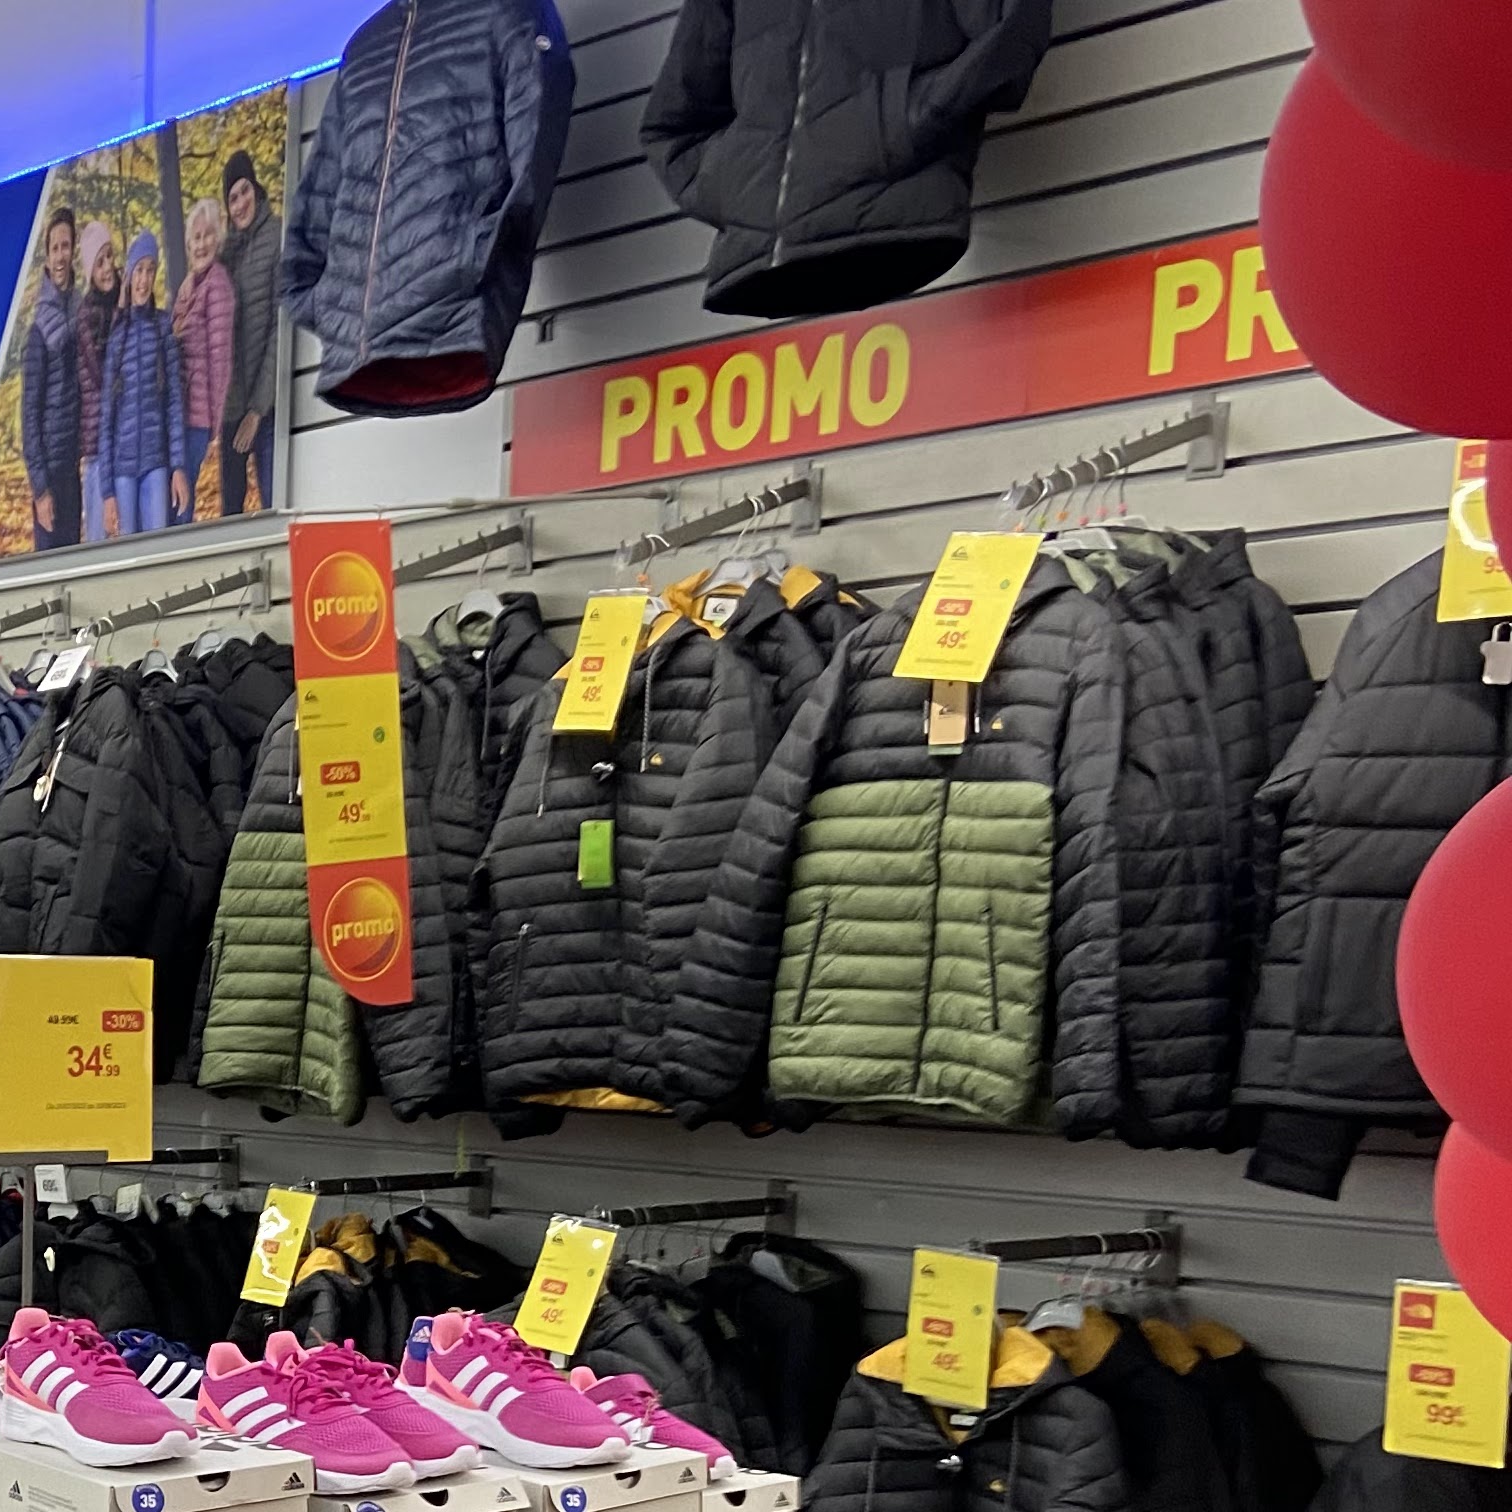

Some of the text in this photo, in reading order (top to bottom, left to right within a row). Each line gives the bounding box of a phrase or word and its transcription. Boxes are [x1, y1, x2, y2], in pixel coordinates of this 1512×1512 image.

[599, 323, 910, 473] PROMO
[314, 591, 378, 623] promo
[332, 917, 395, 947] promo
[106, 1014, 140, 1029] -30%
[139, 1494, 157, 1508] 35
[566, 1494, 580, 1508] 35
